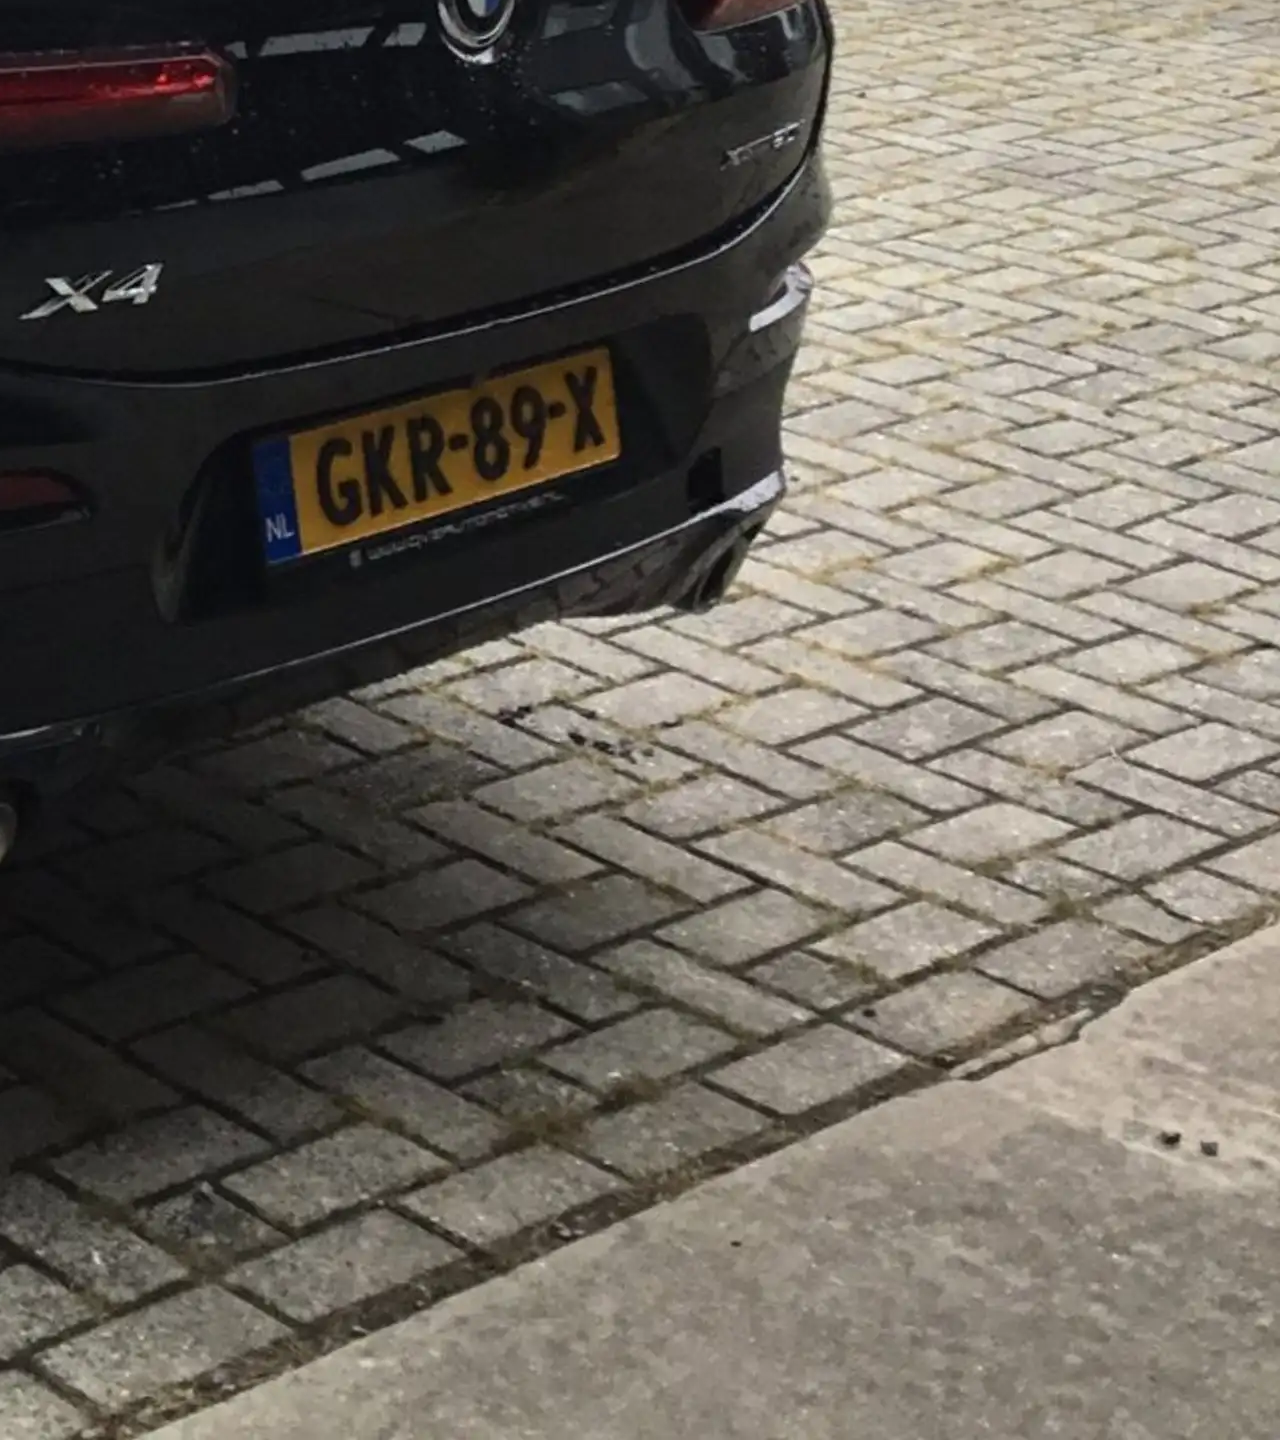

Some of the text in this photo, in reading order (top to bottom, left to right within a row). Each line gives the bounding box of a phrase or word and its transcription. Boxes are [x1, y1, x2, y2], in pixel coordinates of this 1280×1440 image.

[18, 262, 164, 320] X4
[316, 365, 605, 527] GKR-89-X
[265, 512, 296, 543] NL
